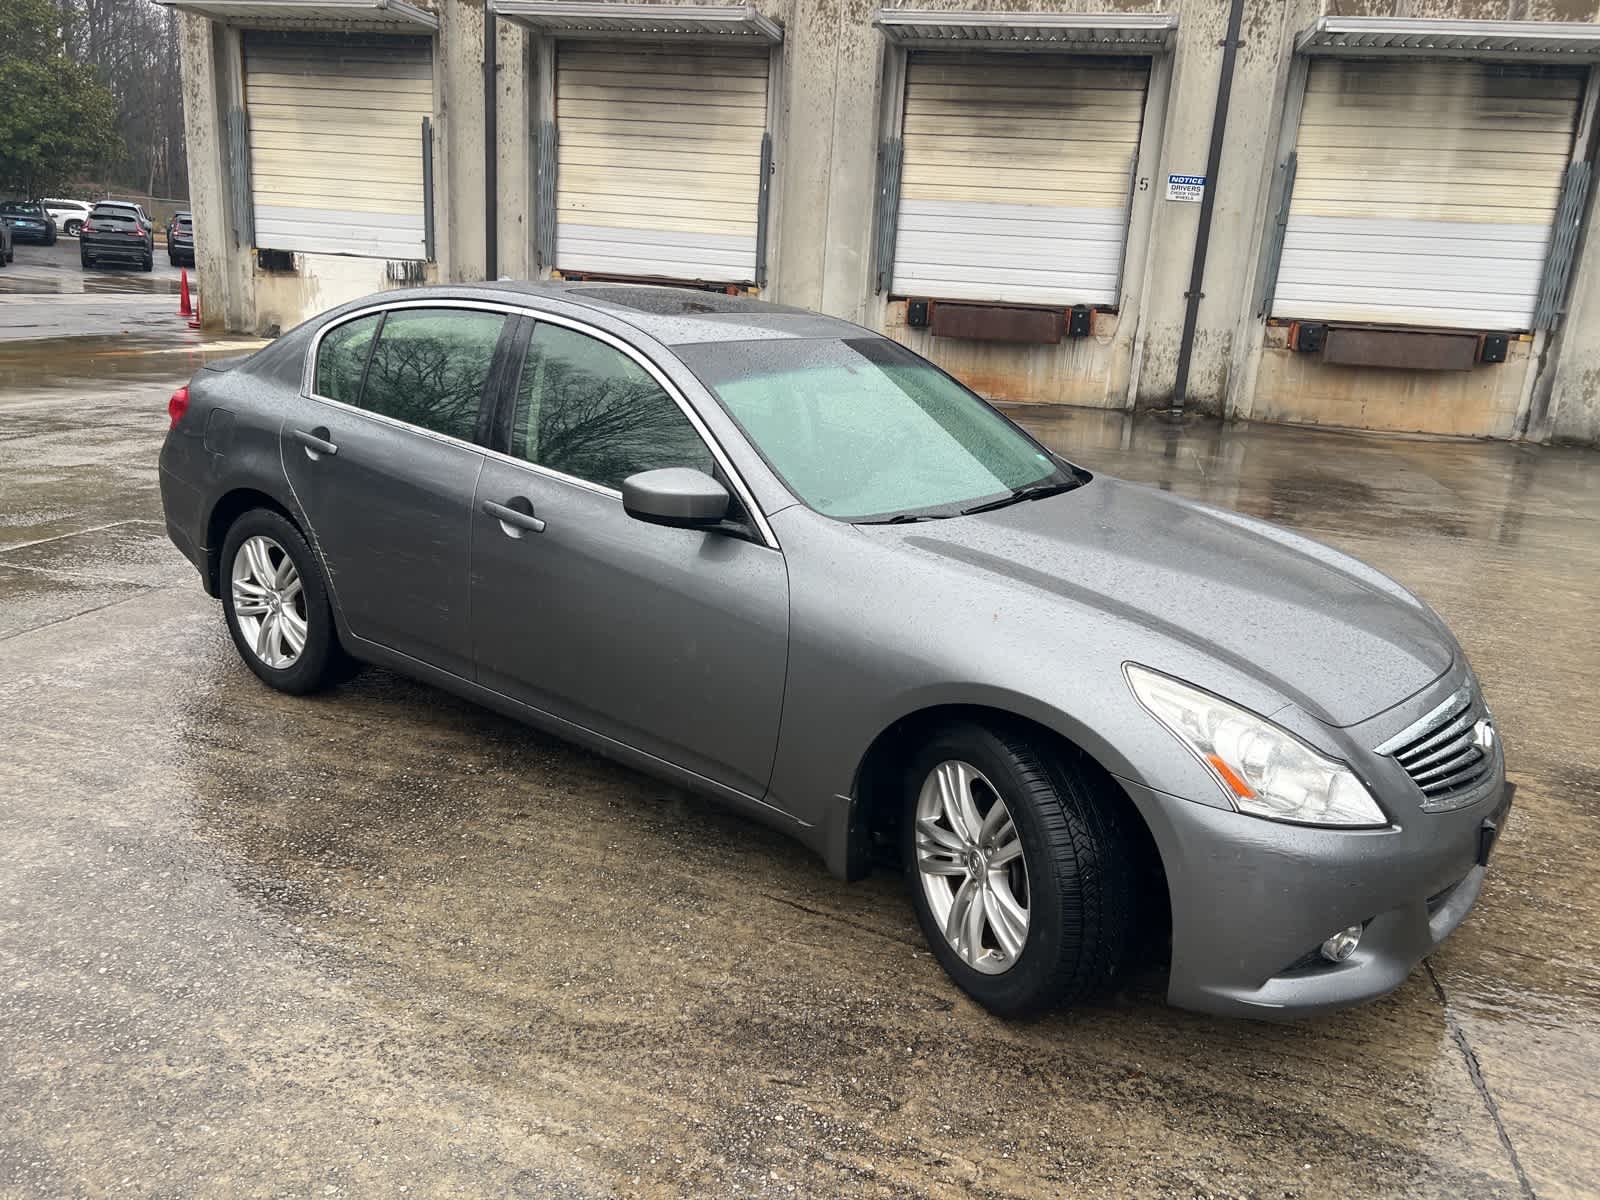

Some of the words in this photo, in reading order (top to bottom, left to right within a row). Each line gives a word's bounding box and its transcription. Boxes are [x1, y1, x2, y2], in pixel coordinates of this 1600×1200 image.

[1139, 177, 1149, 191] 5
[1171, 176, 1204, 185] NOTICE
[1171, 184, 1201, 192] DRIVERS
